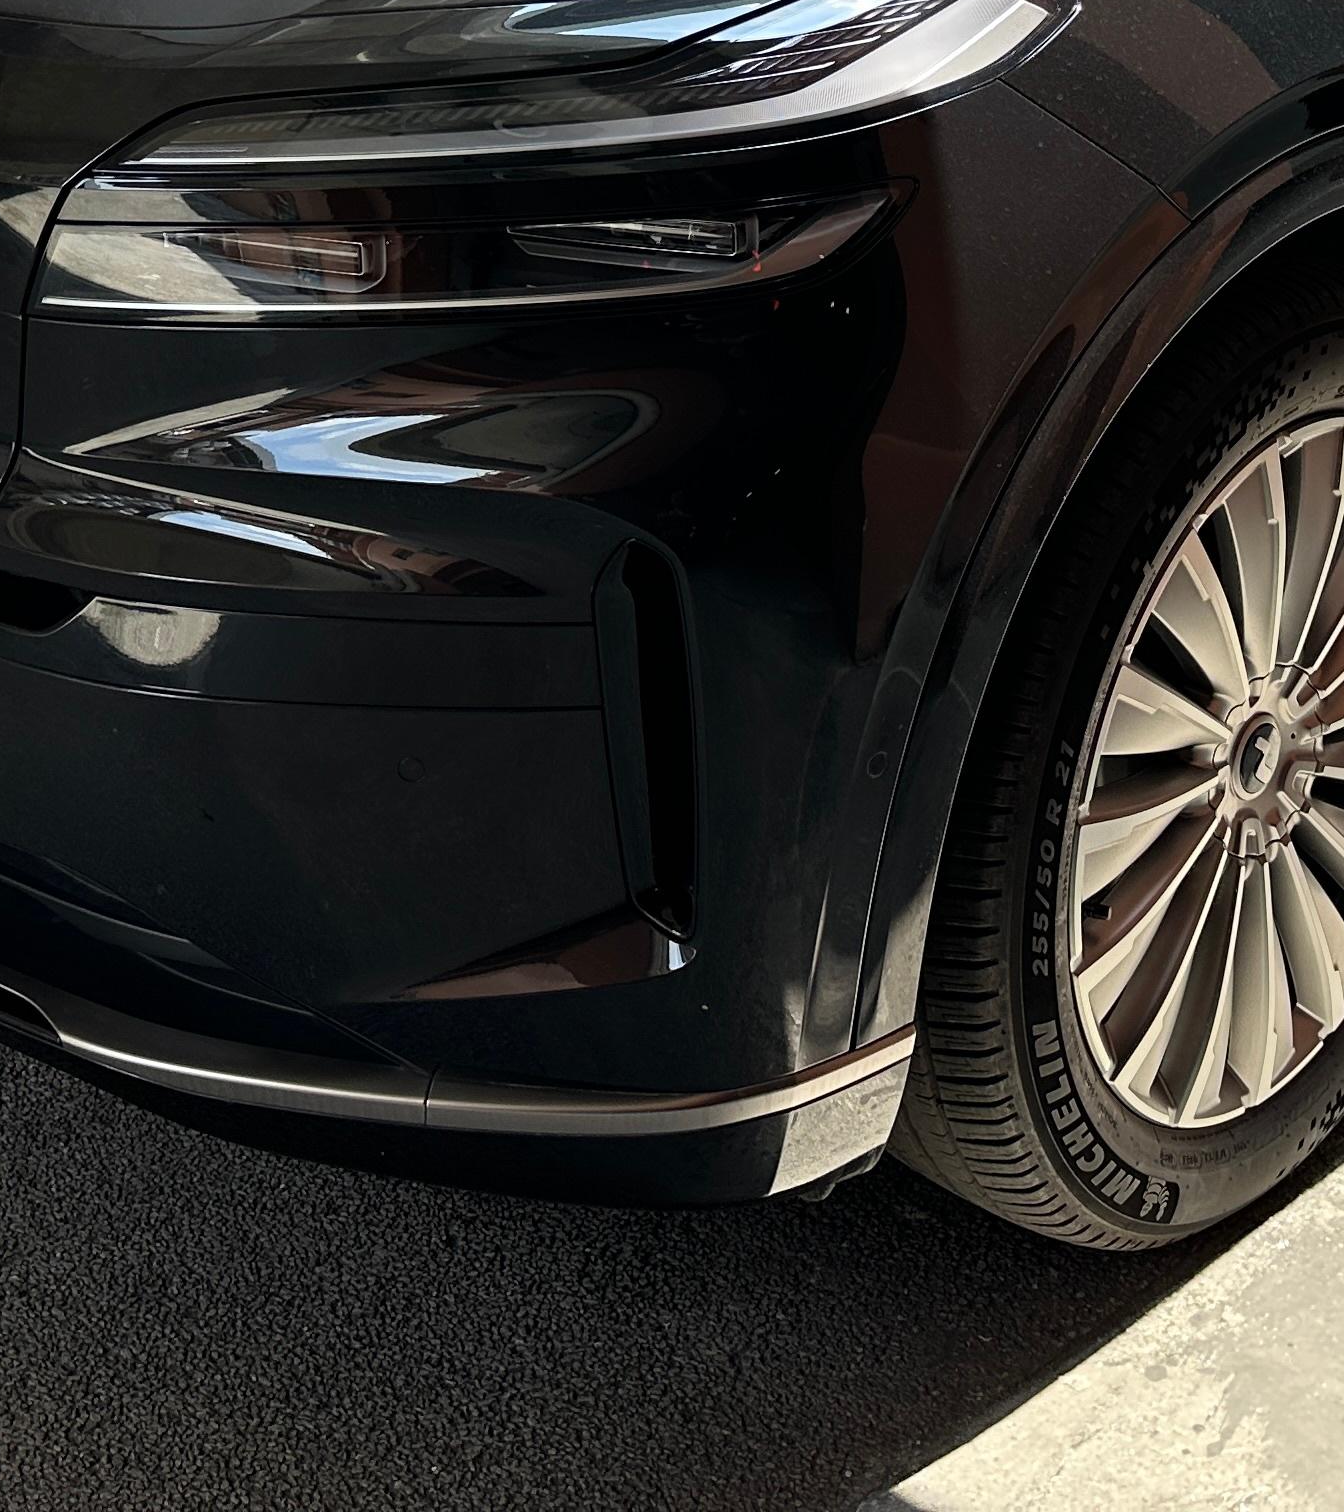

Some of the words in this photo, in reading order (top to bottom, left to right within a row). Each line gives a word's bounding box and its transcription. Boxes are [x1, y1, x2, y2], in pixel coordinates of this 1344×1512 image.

[1031, 839, 1056, 977] 255/50
[1044, 798, 1064, 827] R
[1055, 739, 1076, 787] 21
[1031, 1018, 1142, 1206] MICHELIN
